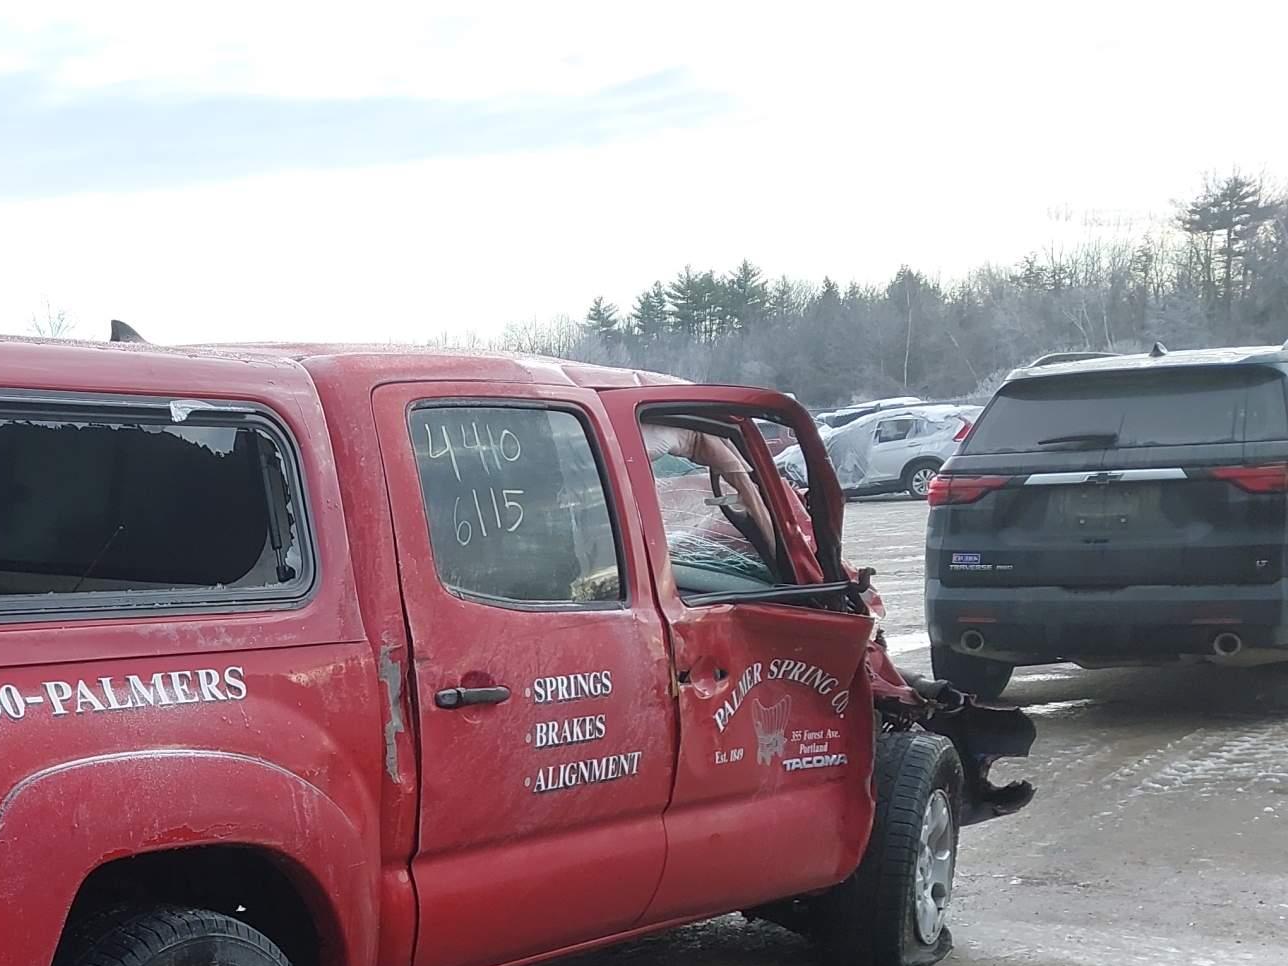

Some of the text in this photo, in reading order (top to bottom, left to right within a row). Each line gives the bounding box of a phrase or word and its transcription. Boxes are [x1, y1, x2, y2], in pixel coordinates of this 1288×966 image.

[424, 421, 521, 482] 4410
[453, 487, 524, 546] 6115
[533, 670, 614, 704] SPRINGS
[712, 661, 763, 733] PALMER
[767, 658, 839, 695] SPRING
[535, 713, 607, 748] BRAKES
[798, 741, 829, 755] Portland
[804, 729, 824, 741] Forest
[533, 751, 642, 793] ALIGNMENT
[782, 753, 848, 771] TACOMA
